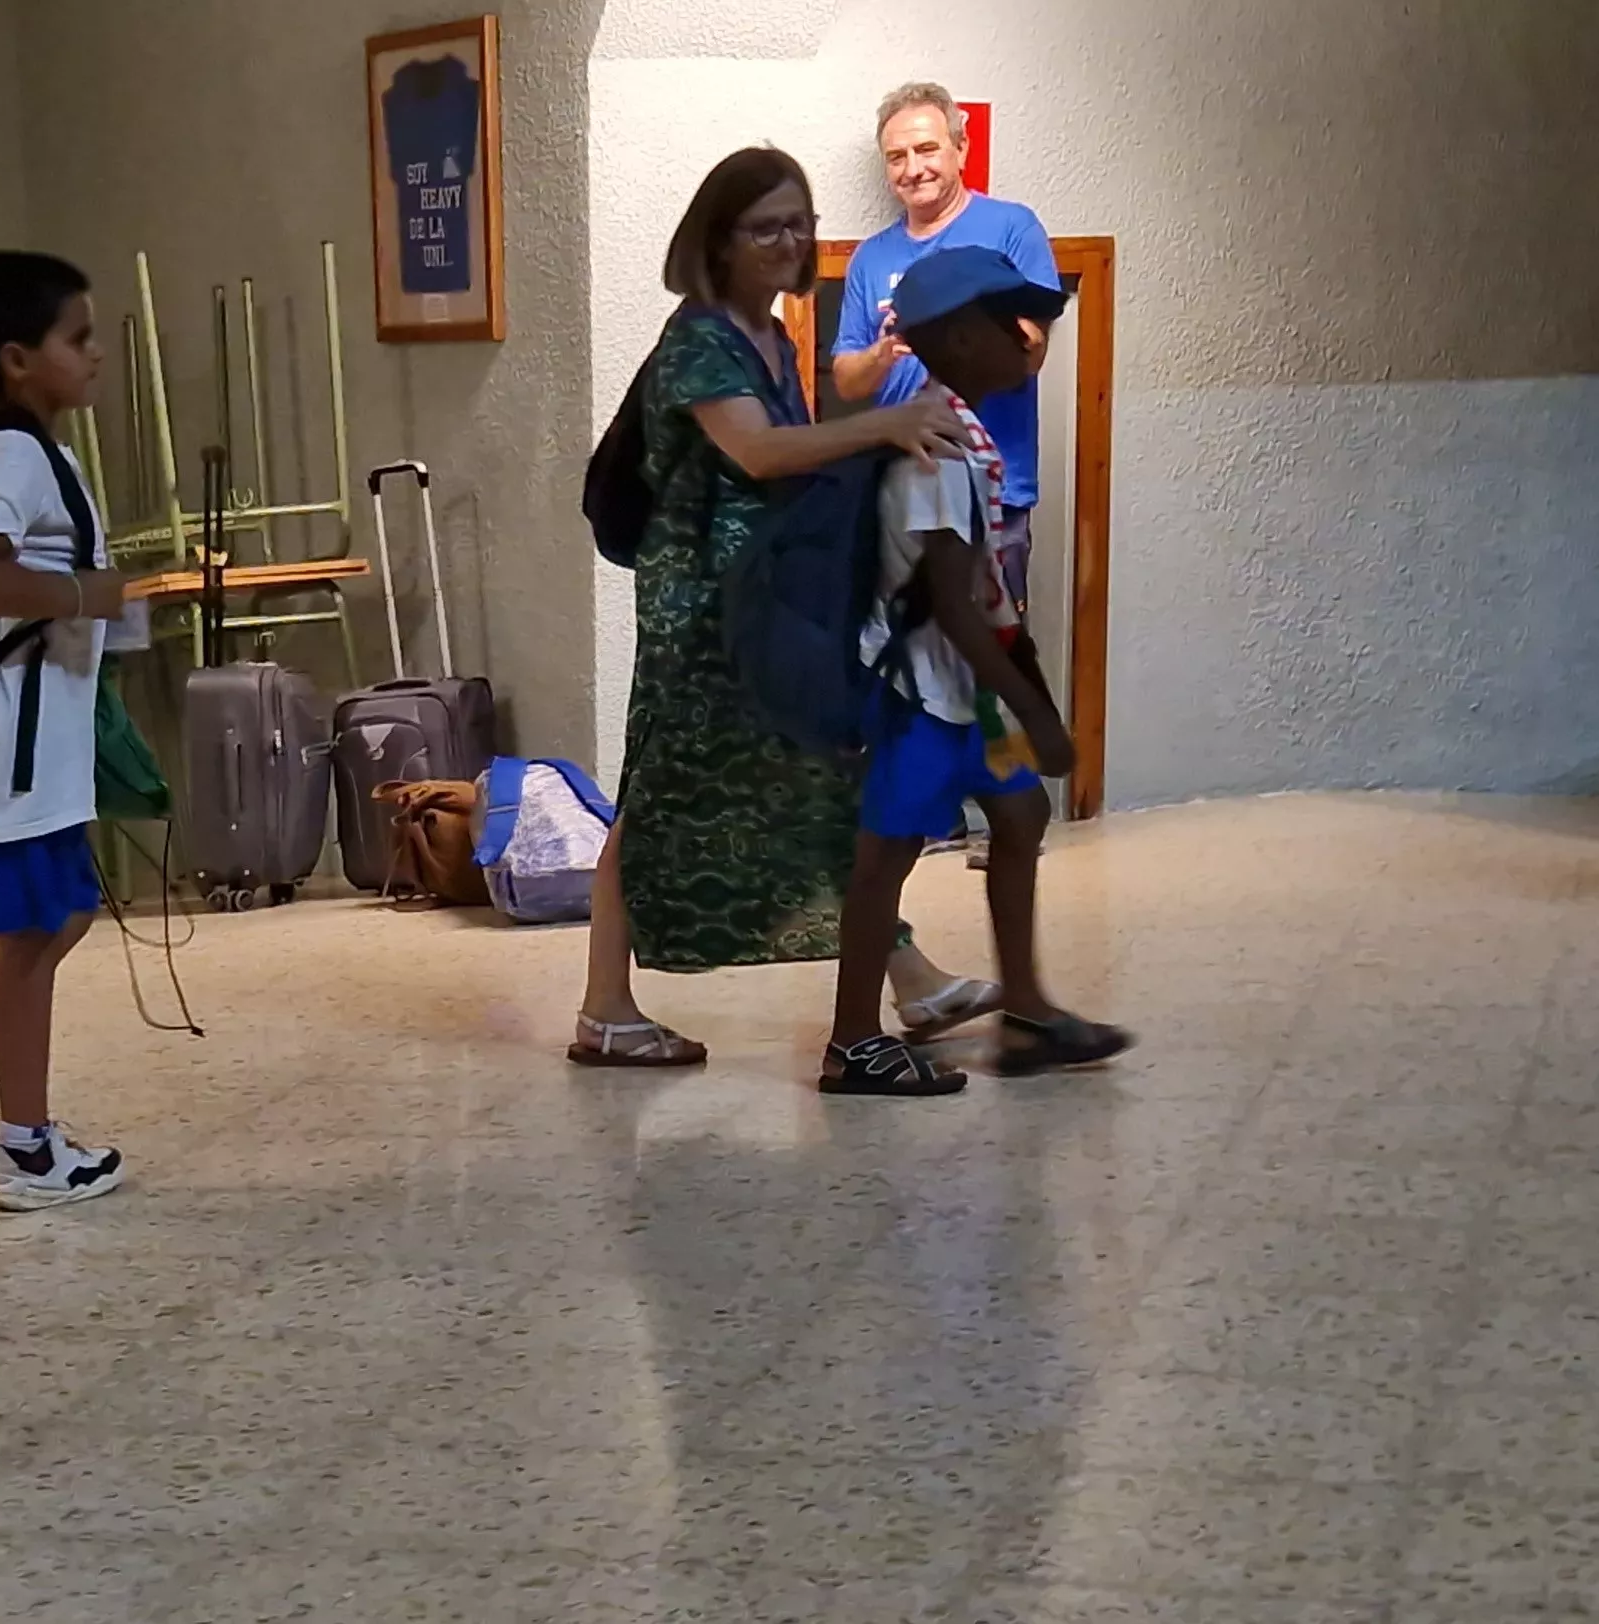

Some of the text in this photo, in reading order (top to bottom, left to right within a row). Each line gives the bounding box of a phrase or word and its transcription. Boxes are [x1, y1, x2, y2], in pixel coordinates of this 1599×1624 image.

[407, 162, 428, 185] SOY
[420, 184, 461, 210] HEAVY
[409, 216, 445, 240] DE LA
